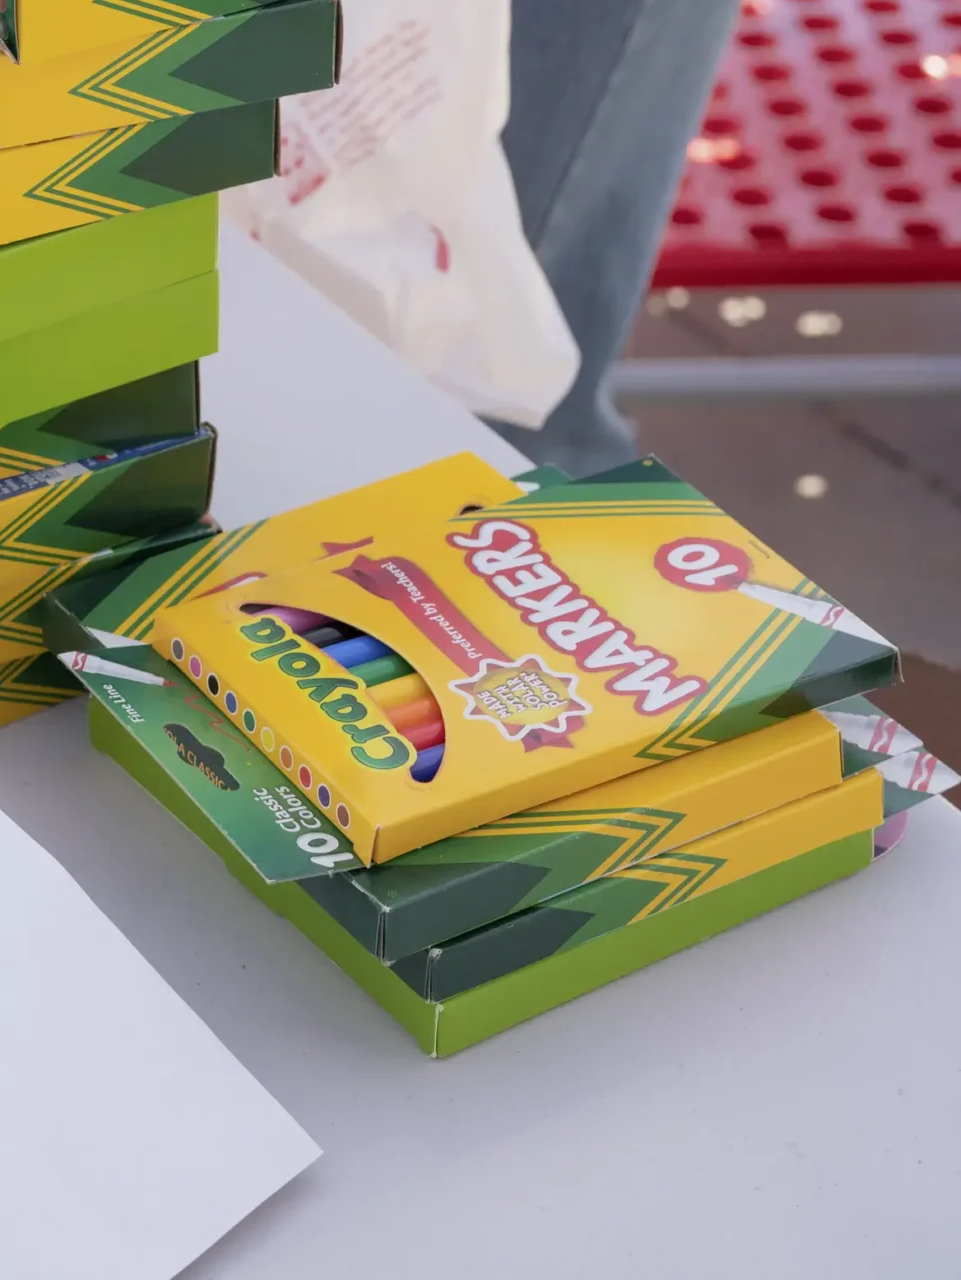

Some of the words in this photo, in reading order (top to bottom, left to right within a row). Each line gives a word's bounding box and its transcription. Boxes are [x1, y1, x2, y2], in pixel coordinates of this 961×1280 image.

[380, 561, 423, 605] Teachers!
[667, 543, 739, 587] 10
[418, 600, 438, 619] by
[452, 519, 701, 712] MARKERS
[429, 612, 484, 660] Preferred
[103, 683, 126, 707] Line
[123, 703, 145, 723] Fine
[239, 617, 411, 770] Crayola
[477, 691, 511, 719] MADE
[494, 685, 527, 712] WITH
[507, 677, 549, 710] SOLAR
[252, 788, 301, 833] Classic
[274, 785, 321, 829] Colors
[296, 832, 355, 868] 10
